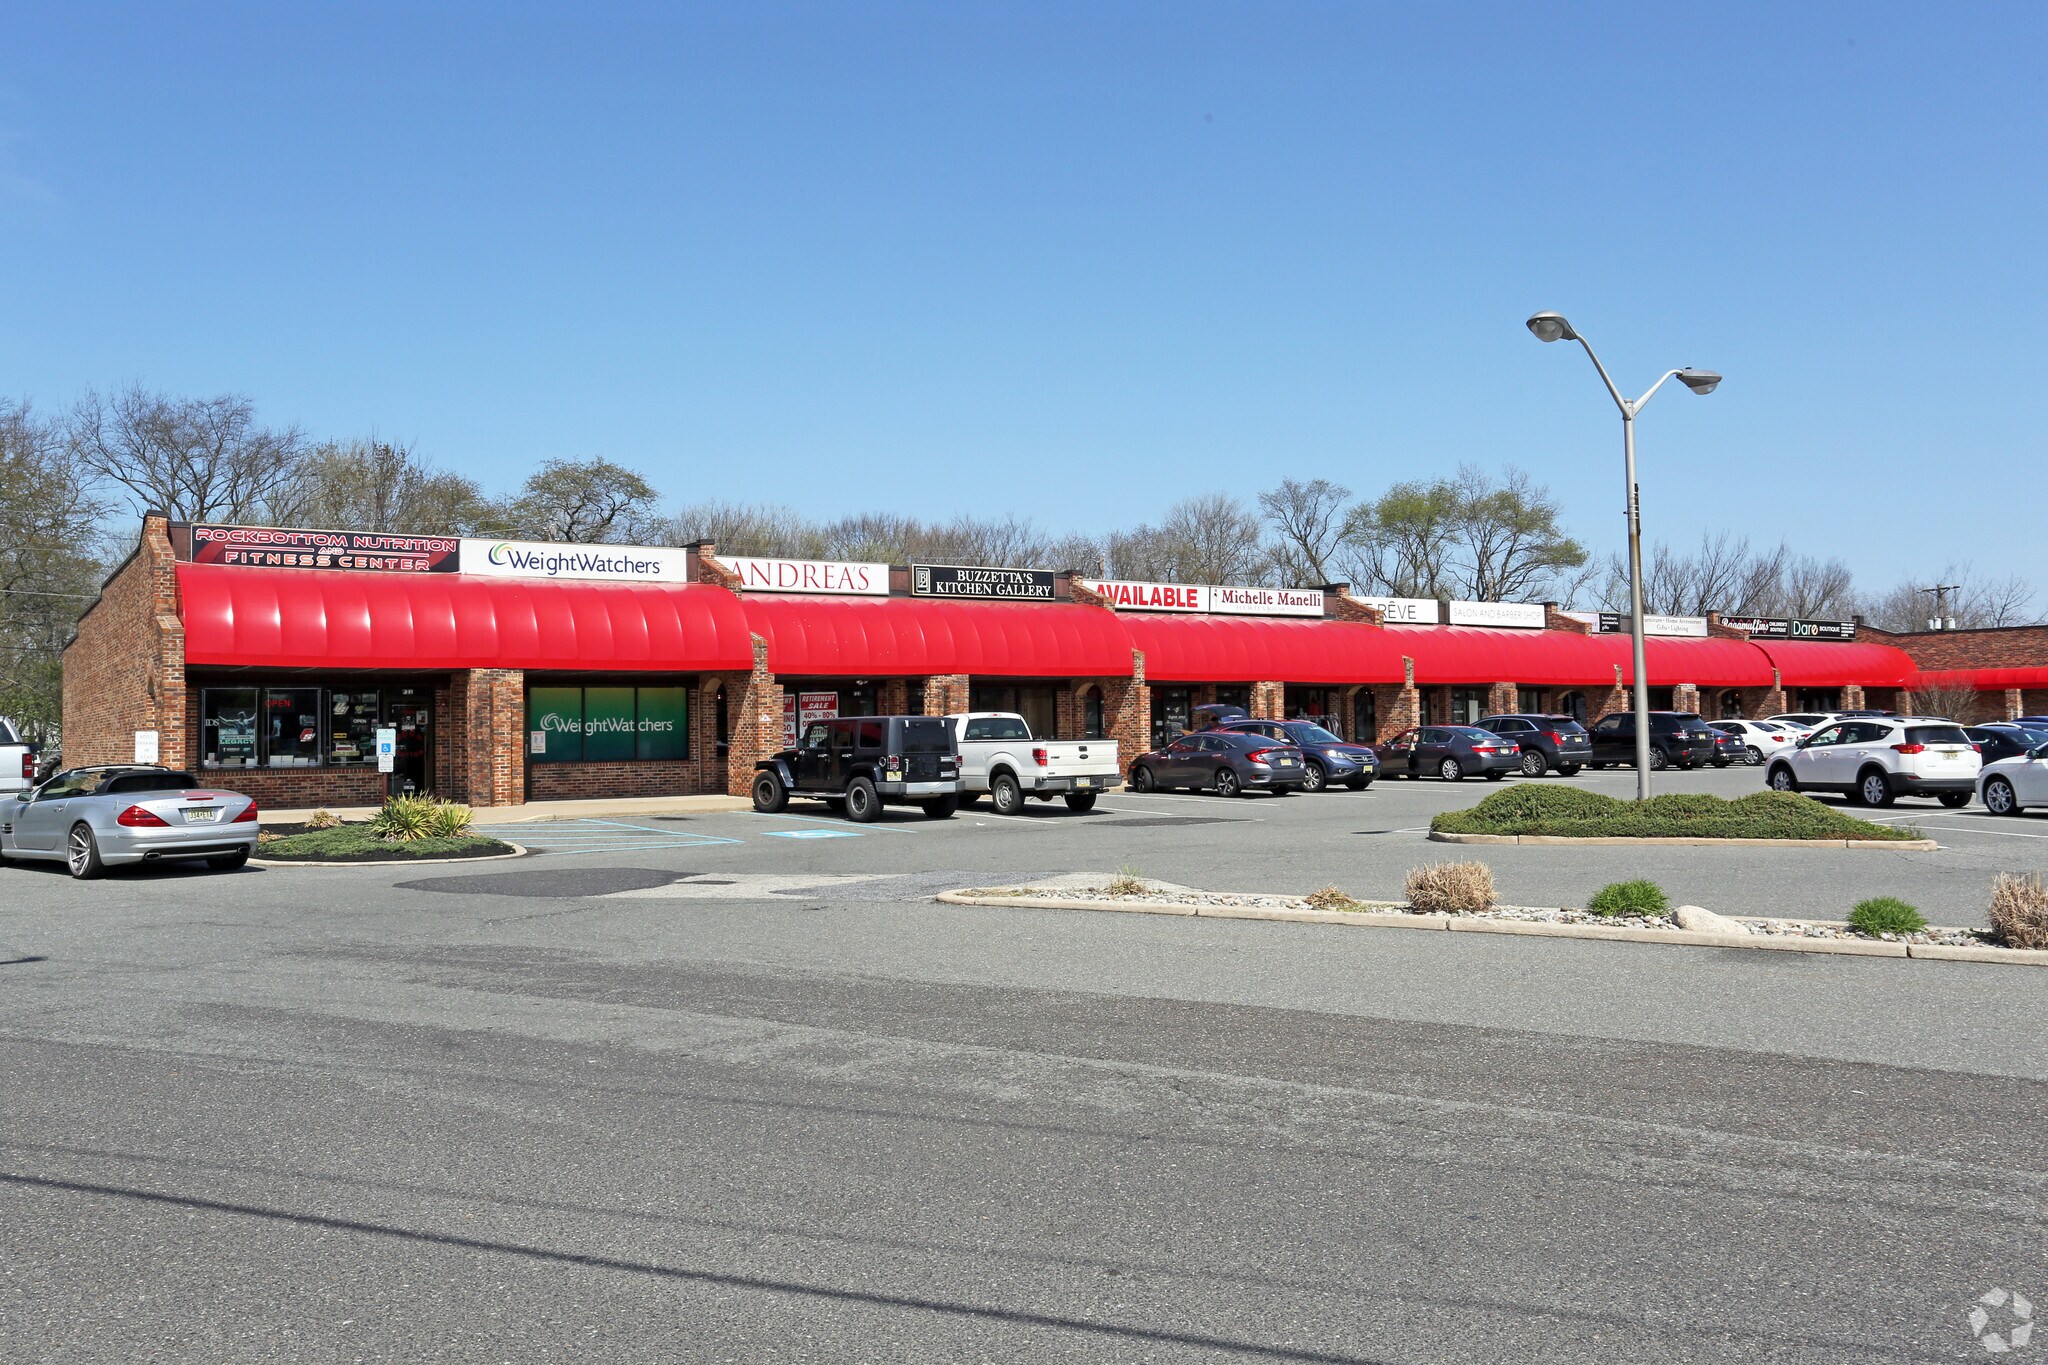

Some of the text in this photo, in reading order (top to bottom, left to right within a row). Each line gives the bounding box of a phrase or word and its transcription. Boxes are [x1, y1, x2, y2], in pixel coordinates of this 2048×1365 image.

[196, 528, 456, 552] ROCKBOTTOM NUTRITION
[318, 547, 344, 555] AND
[225, 551, 430, 571] FITNESS CENTER
[507, 550, 660, 575] WeightWatchers
[732, 561, 869, 591] ANDREA'S
[956, 570, 1033, 584] BUZZETTA'S
[936, 581, 1052, 597] KITCHEN GALLERY
[1096, 584, 1198, 608] AVAILABLE
[1221, 589, 1321, 606] Michelle Manelli
[1378, 601, 1416, 619] RÊVE
[1453, 607, 1541, 620] SALON AND BARBER SHOP
[265, 699, 292, 708] OPEN
[554, 718, 673, 736] WeightWatchers
